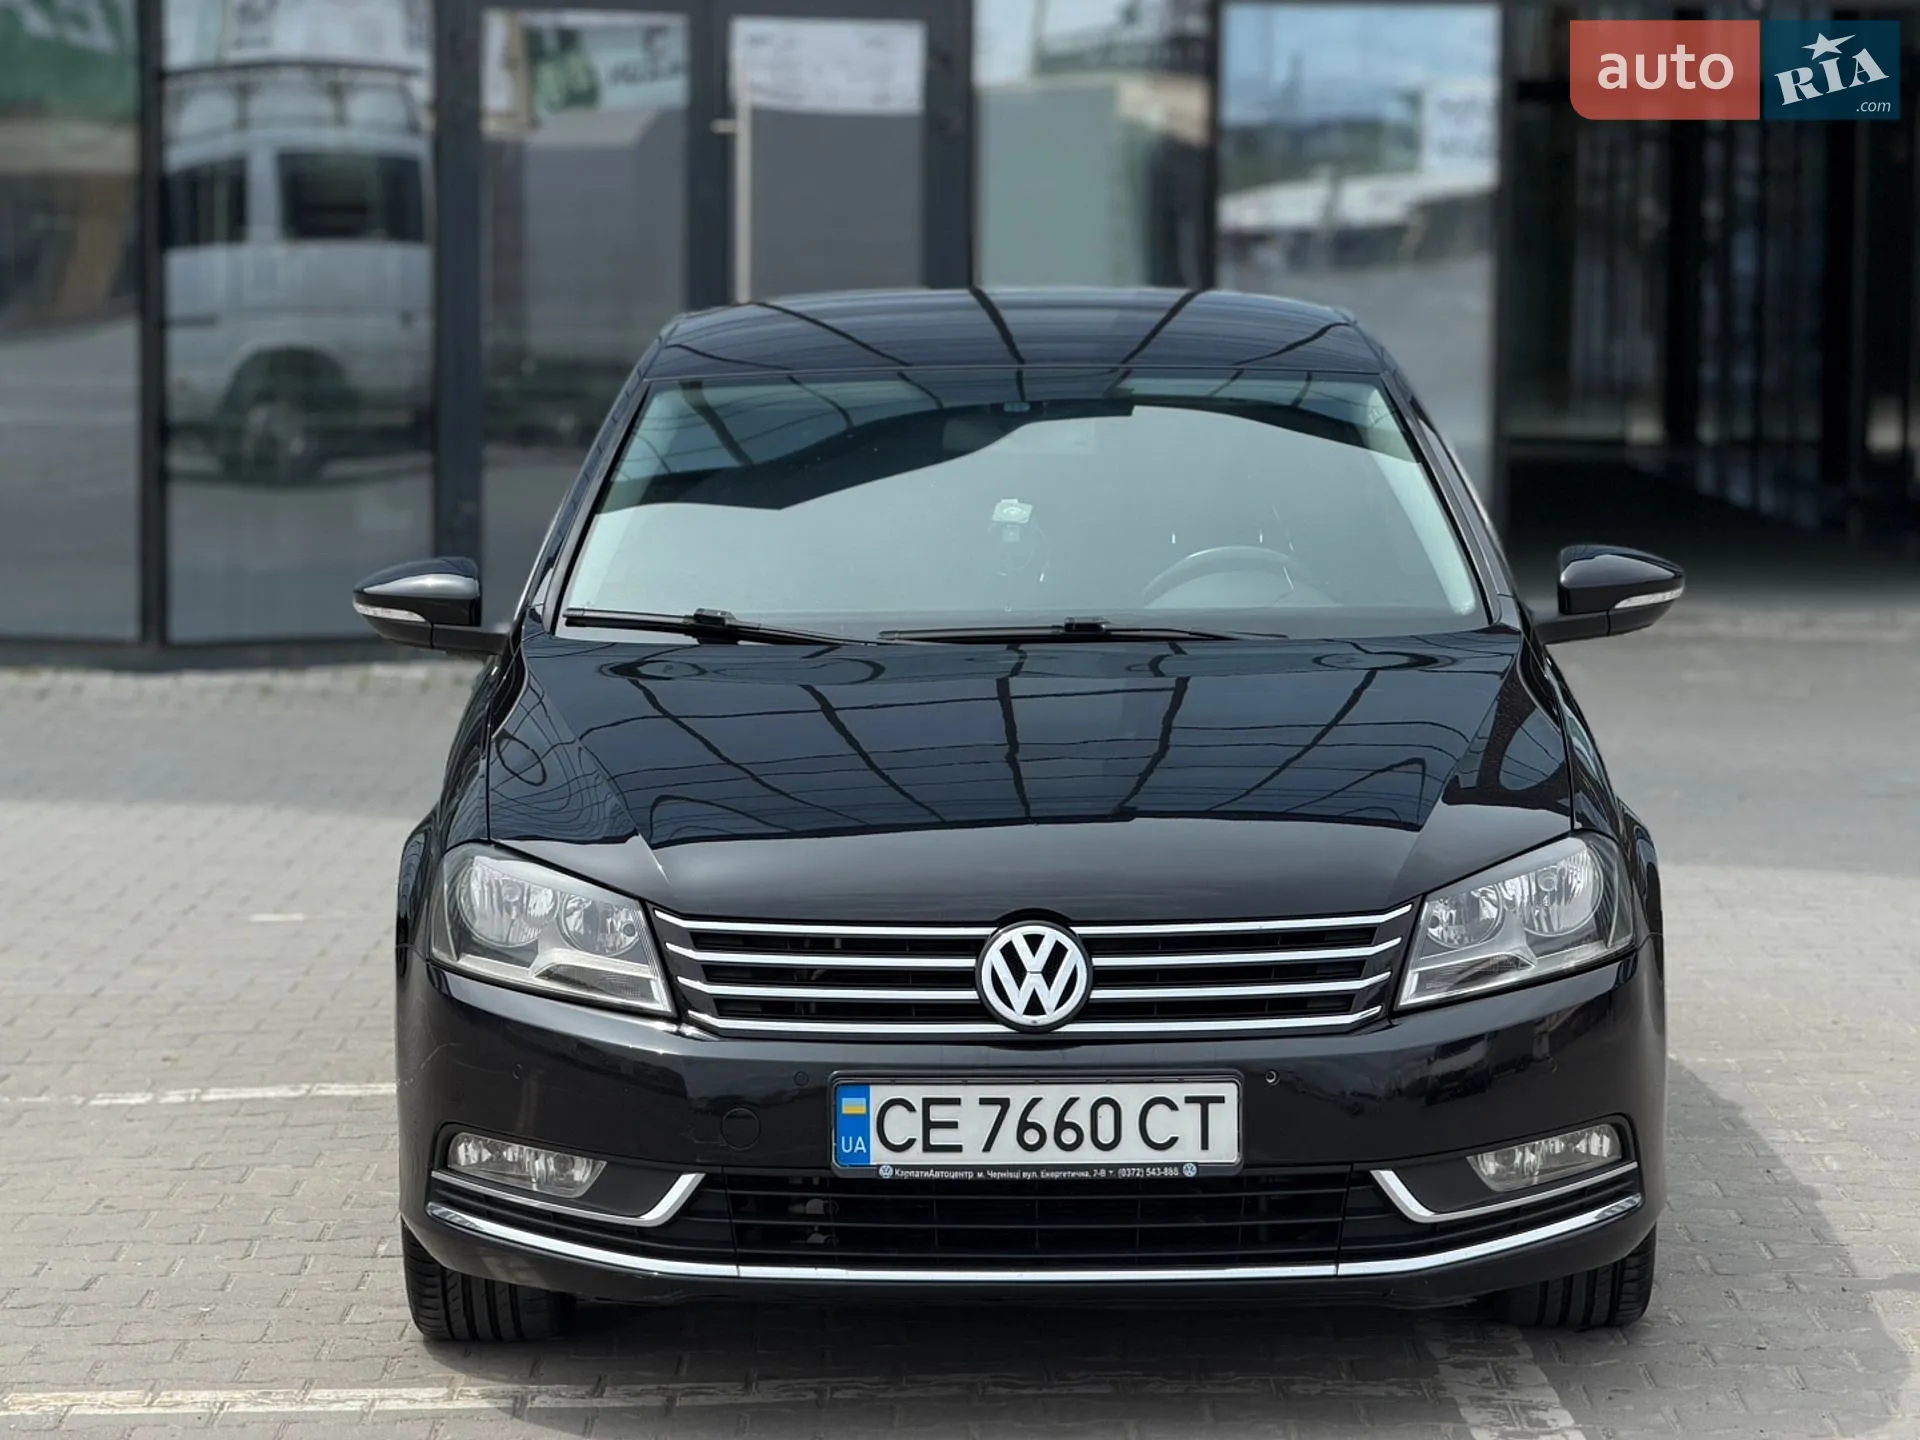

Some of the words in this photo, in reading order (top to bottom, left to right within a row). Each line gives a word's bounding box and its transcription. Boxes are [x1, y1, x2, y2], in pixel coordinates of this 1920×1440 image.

[875, 1096, 963, 1153] CE
[978, 1096, 1122, 1153] 7660
[1138, 1095, 1226, 1152] CT
[841, 1135, 867, 1154] UA
